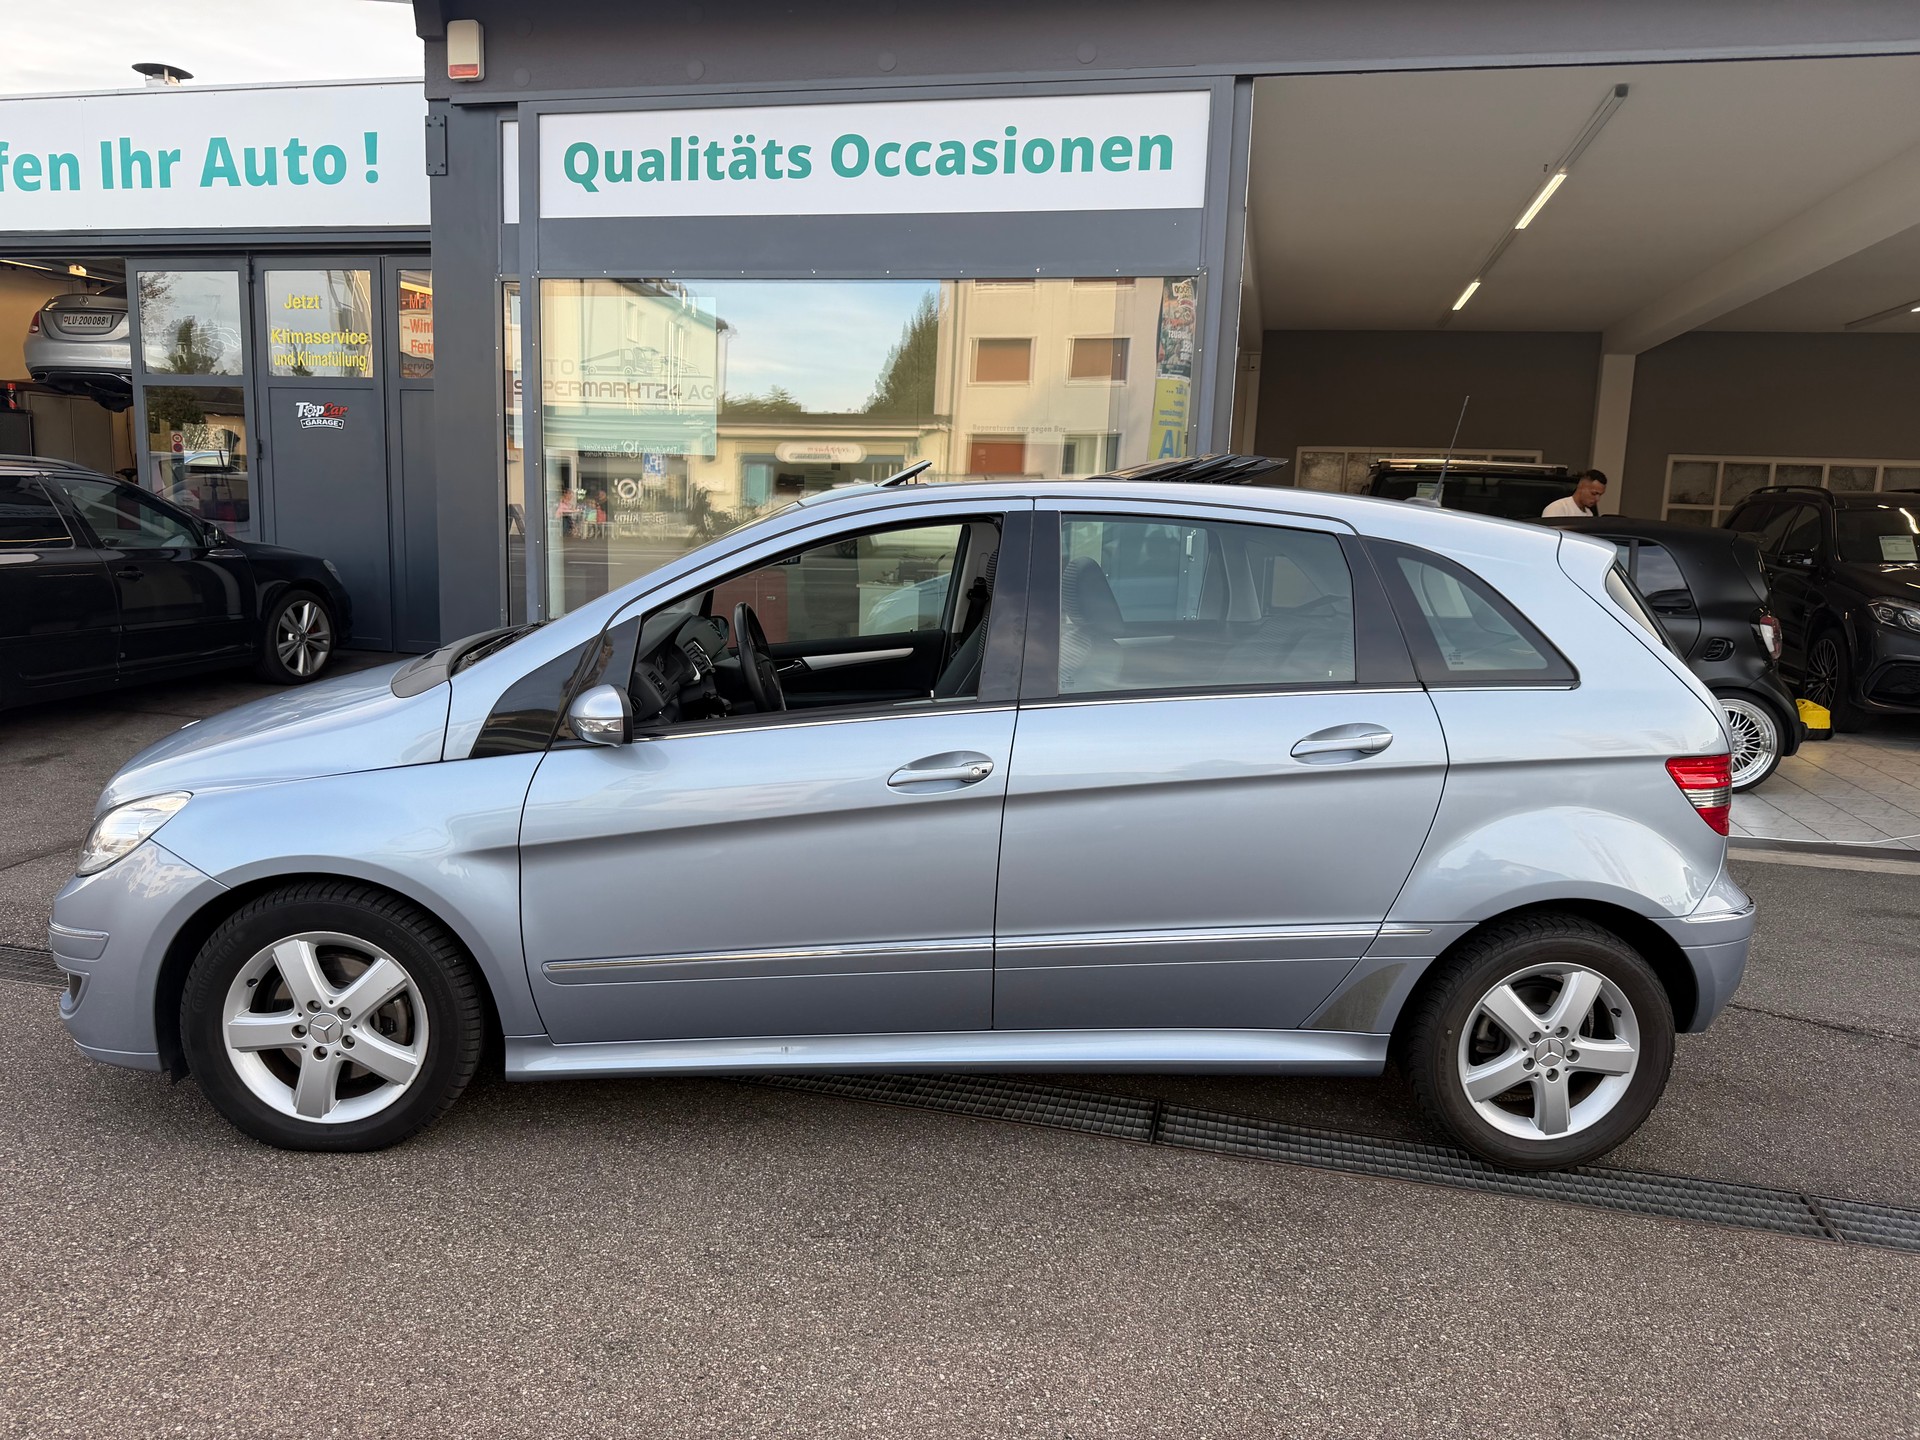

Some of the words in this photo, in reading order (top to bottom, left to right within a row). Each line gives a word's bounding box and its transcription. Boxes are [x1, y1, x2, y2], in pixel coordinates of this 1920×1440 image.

[100, 137, 181, 190] Ihr
[199, 136, 347, 188] Auto
[563, 134, 812, 193] Qualitäts
[830, 126, 1175, 179] Occasionen
[283, 293, 321, 310] Jetzt
[271, 328, 368, 345] Klimaservice
[273, 351, 294, 366] und
[297, 350, 368, 371] Klimafüllung
[688, 384, 715, 400] AG
[305, 419, 339, 427] GARAGE
[972, 424, 1015, 432] Reparaturen
[1031, 425, 1052, 433] gegen
